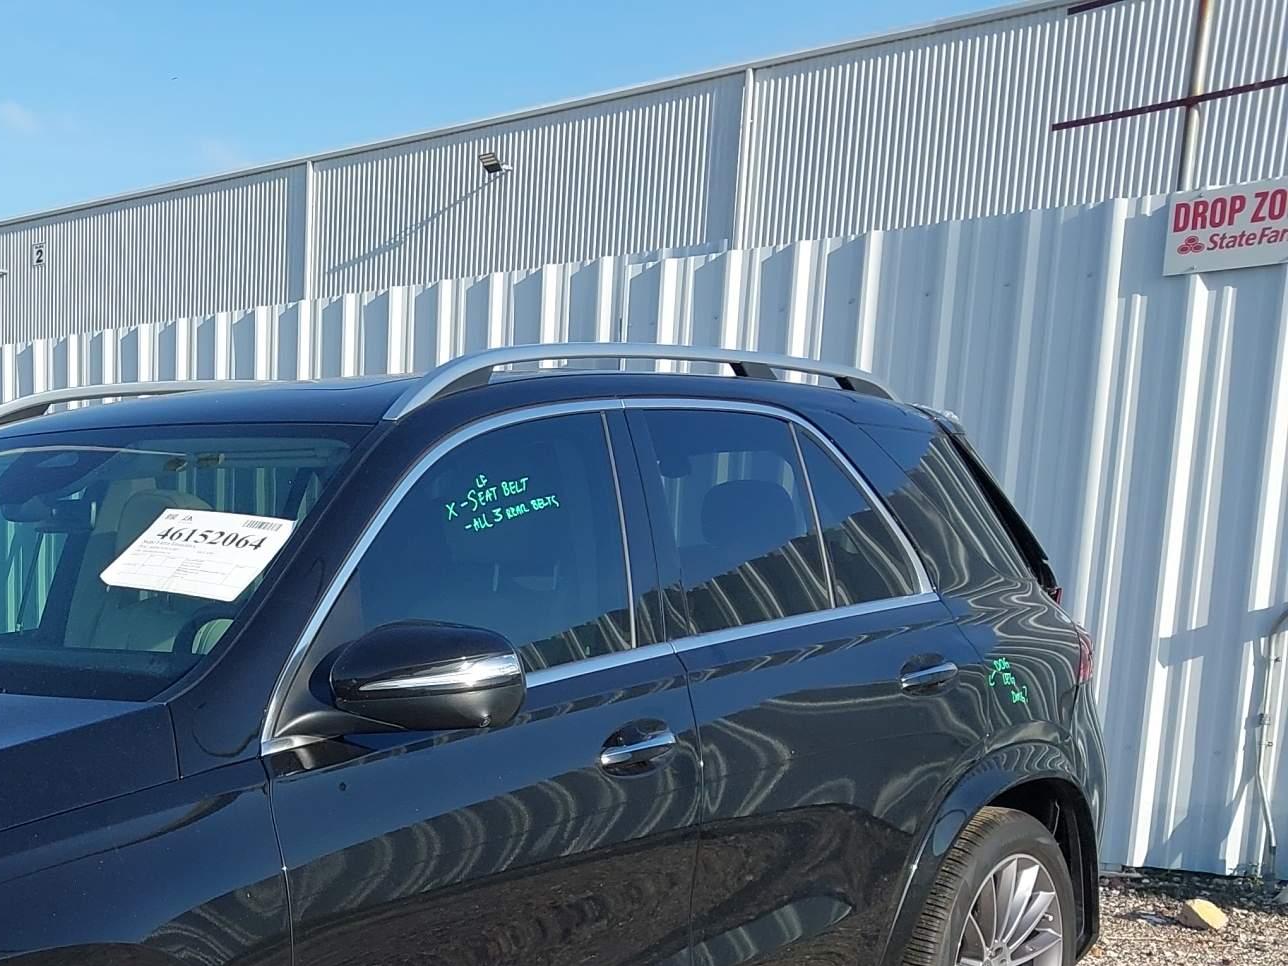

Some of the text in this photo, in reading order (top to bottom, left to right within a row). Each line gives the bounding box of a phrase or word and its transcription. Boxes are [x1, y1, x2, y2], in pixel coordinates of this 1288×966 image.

[1173, 188, 1288, 233] DROP ZO
[1206, 226, 1288, 251] State Far
[35, 249, 44, 263] 2
[501, 477, 529, 496] BELT
[492, 507, 504, 522] 3
[530, 495, 560, 511] BELTS
[157, 526, 268, 551] 46152064
